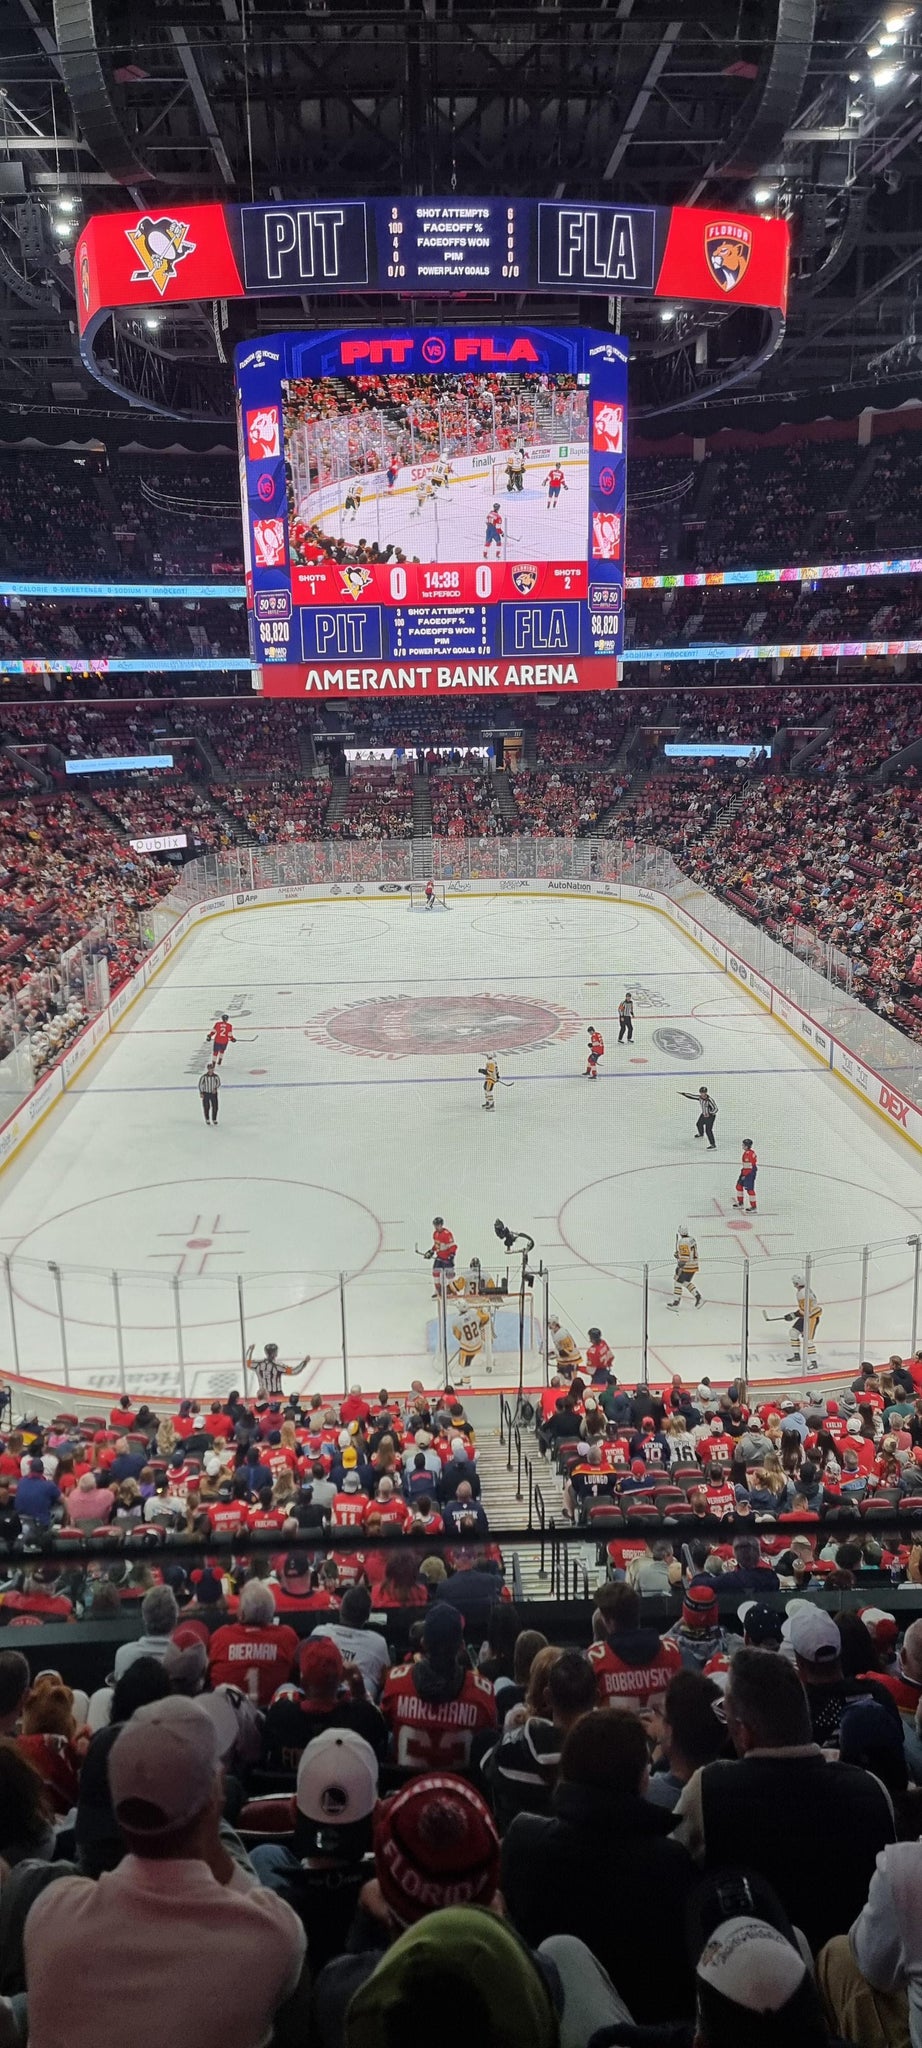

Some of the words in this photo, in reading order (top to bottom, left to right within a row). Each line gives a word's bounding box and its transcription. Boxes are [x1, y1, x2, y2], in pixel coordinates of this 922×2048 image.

[392, 208, 398, 219] 3
[417, 209, 441, 218] SHOT
[442, 209, 489, 218] ATTEMPTS
[508, 208, 513, 220] 6
[388, 222, 403, 234] 100
[424, 223, 474, 232] FACEOFF
[474, 223, 483, 232] %
[508, 223, 513, 234] 0
[709, 226, 748, 242] FLORIDA
[265, 211, 343, 279] PIT
[393, 237, 398, 248] 4
[417, 238, 466, 246] FACEOFFS
[467, 238, 490, 246] WON
[508, 237, 513, 249] 0
[558, 211, 636, 280] FLA
[393, 251, 399, 263] 0
[444, 252, 463, 261] PIM
[508, 251, 514, 263] 0
[418, 266, 444, 276] POWER
[445, 266, 464, 276] PLAY
[465, 266, 490, 276] GOALS
[341, 340, 414, 364] PIT
[428, 345, 440, 356] VS
[454, 338, 539, 362] FLA
[390, 567, 406, 600] 0
[424, 571, 459, 588] 14:38
[476, 565, 492, 598] 0
[564, 577, 571, 589] 2
[310, 582, 315, 595] 1
[592, 592, 601, 602] 50
[609, 592, 618, 602] 50
[260, 599, 269, 610] 50
[277, 598, 287, 609] 50
[397, 609, 401, 617] 3
[408, 608, 430, 616] SHOT
[394, 618, 404, 626] 100
[591, 614, 619, 637] $8,820
[260, 622, 290, 644] $8,820
[316, 614, 366, 653] PIT
[408, 628, 454, 636] FACEOFFS
[515, 609, 568, 648] FLA
[398, 638, 402, 646] 0
[482, 636, 486, 644] 0
[305, 667, 432, 691] AMERANT
[437, 665, 499, 687] BANK
[504, 664, 579, 686] ARENA
[136, 838, 178, 852] Publix
[548, 881, 591, 891] AutoNation
[879, 1085, 910, 1128] DEX
[462, 1323, 479, 1341] 82
[675, 1445, 694, 1461] 16
[584, 1475, 608, 1485] LUONGO
[228, 1644, 278, 1661] BIERMAN
[245, 1668, 260, 1701] 1
[604, 1667, 674, 1693] BOBROVSKY
[398, 1696, 478, 1726] MARCHAND
